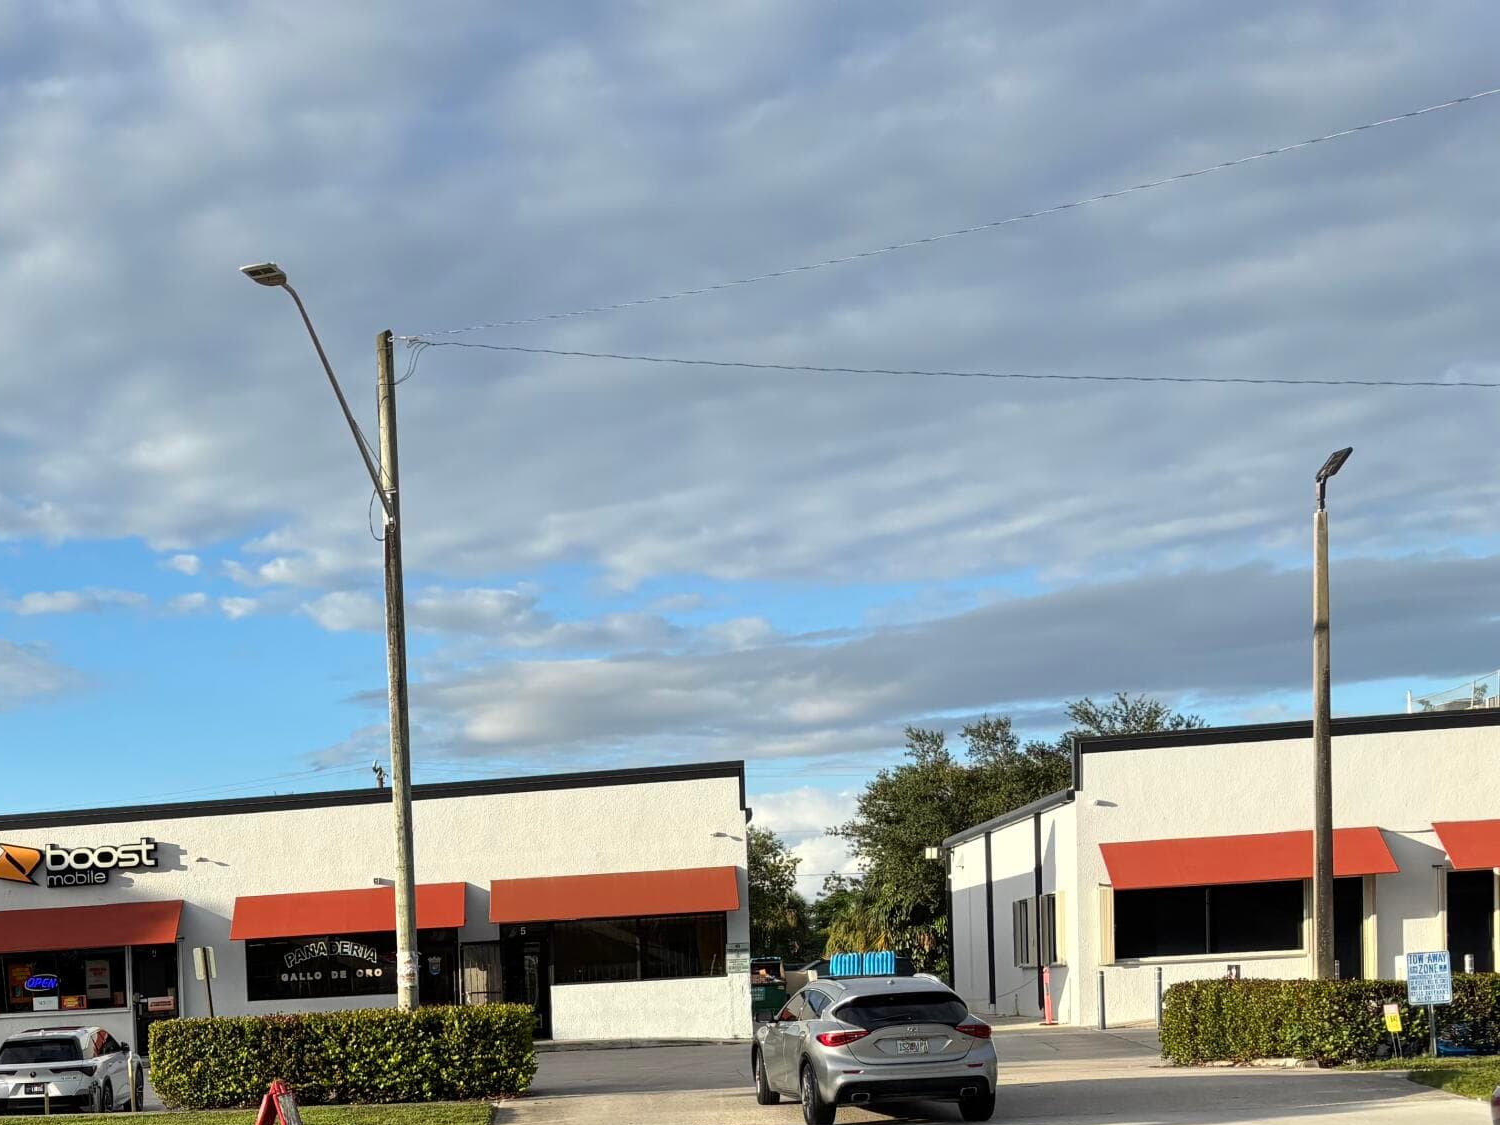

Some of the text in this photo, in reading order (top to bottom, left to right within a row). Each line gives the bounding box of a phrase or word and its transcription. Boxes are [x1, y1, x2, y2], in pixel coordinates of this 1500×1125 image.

[46, 838, 156, 871] boost
[47, 870, 106, 887] mobile
[520, 926, 526, 935] 5
[1409, 953, 1446, 964] TOW AWAY
[281, 968, 383, 982] GALLO DE ORO
[1418, 964, 1438, 974] ZONE
[27, 977, 57, 989] OPEN
